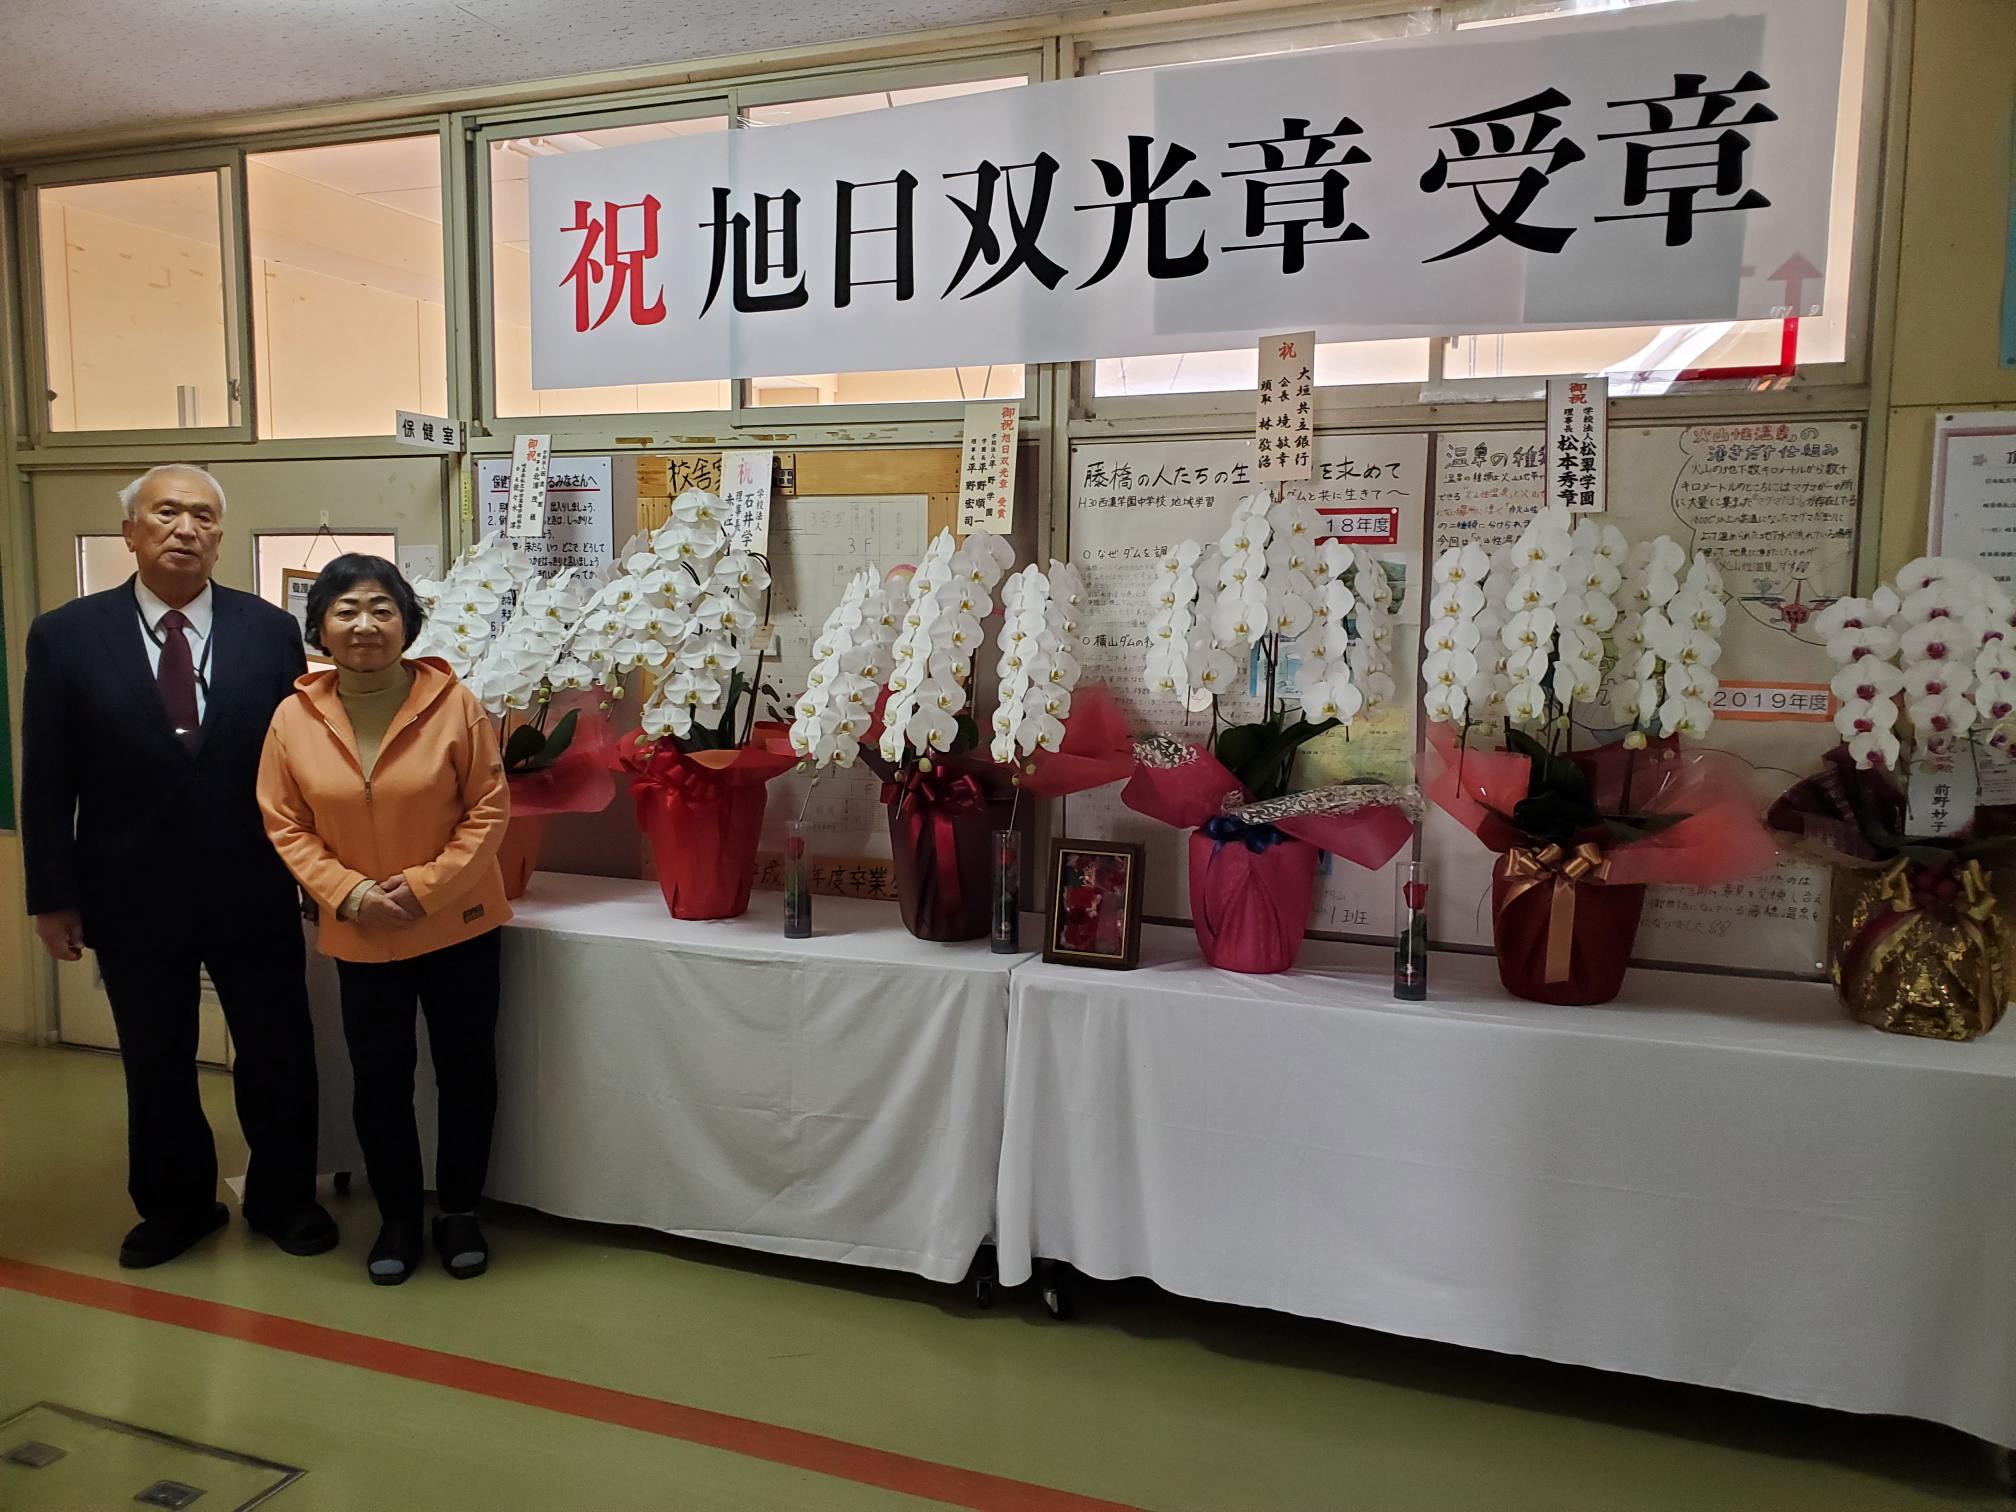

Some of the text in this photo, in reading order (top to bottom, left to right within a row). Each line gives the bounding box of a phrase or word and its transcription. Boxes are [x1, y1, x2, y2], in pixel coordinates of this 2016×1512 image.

[559, 69, 1779, 333] 祝 旭日双光章 受章
[1278, 341, 1297, 360] 祝
[1568, 382, 1588, 405] 御祝
[1294, 366, 1312, 467] 大垣共立銀行
[402, 418, 455, 446] 保健室
[737, 458, 754, 486] 祝
[1712, 690, 1829, 712] 2019年度
